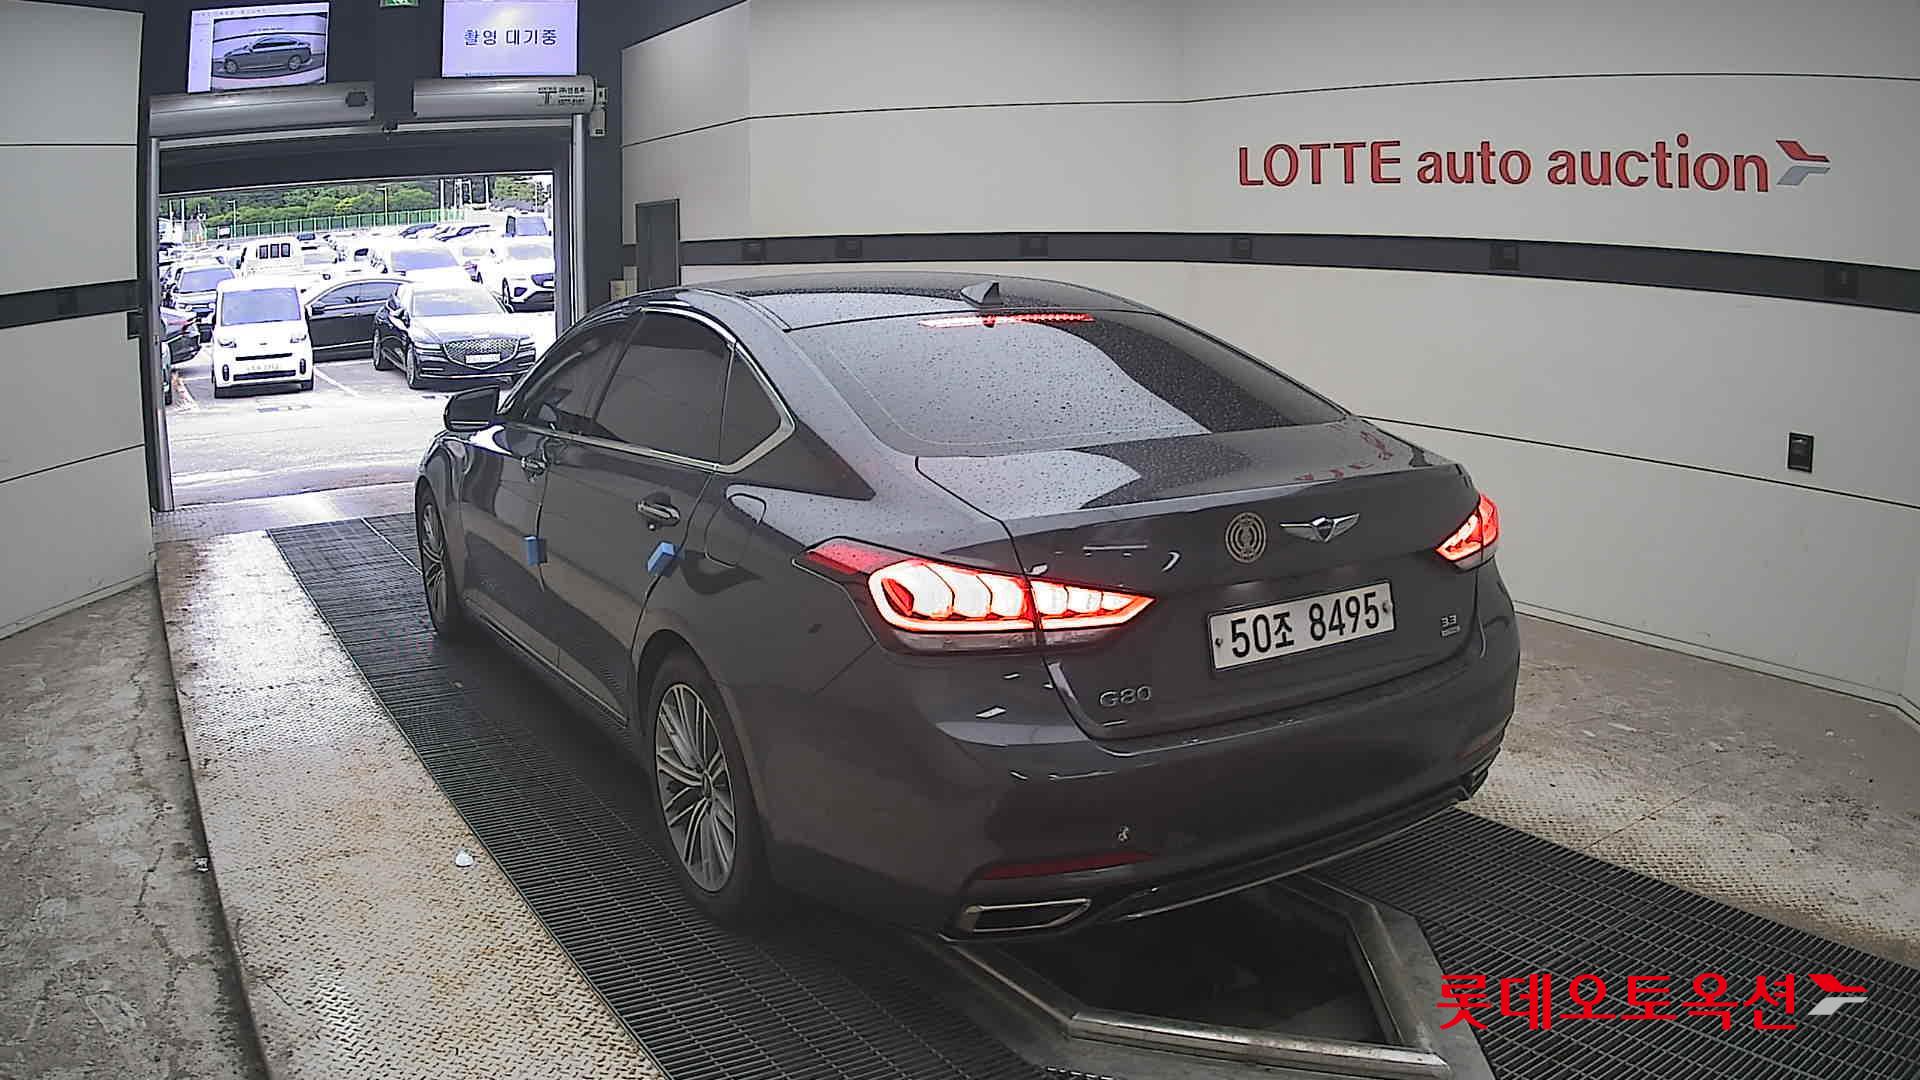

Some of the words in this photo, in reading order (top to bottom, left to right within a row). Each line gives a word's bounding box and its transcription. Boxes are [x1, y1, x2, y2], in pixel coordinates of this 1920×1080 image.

[505, 28, 558, 46] 대기중
[1239, 140, 1400, 187] LOTTE
[1417, 141, 1531, 185] auto
[1547, 133, 1769, 192] auction
[1230, 611, 1295, 658] 50조
[1308, 591, 1380, 641] 8495
[1099, 685, 1152, 707] G80
